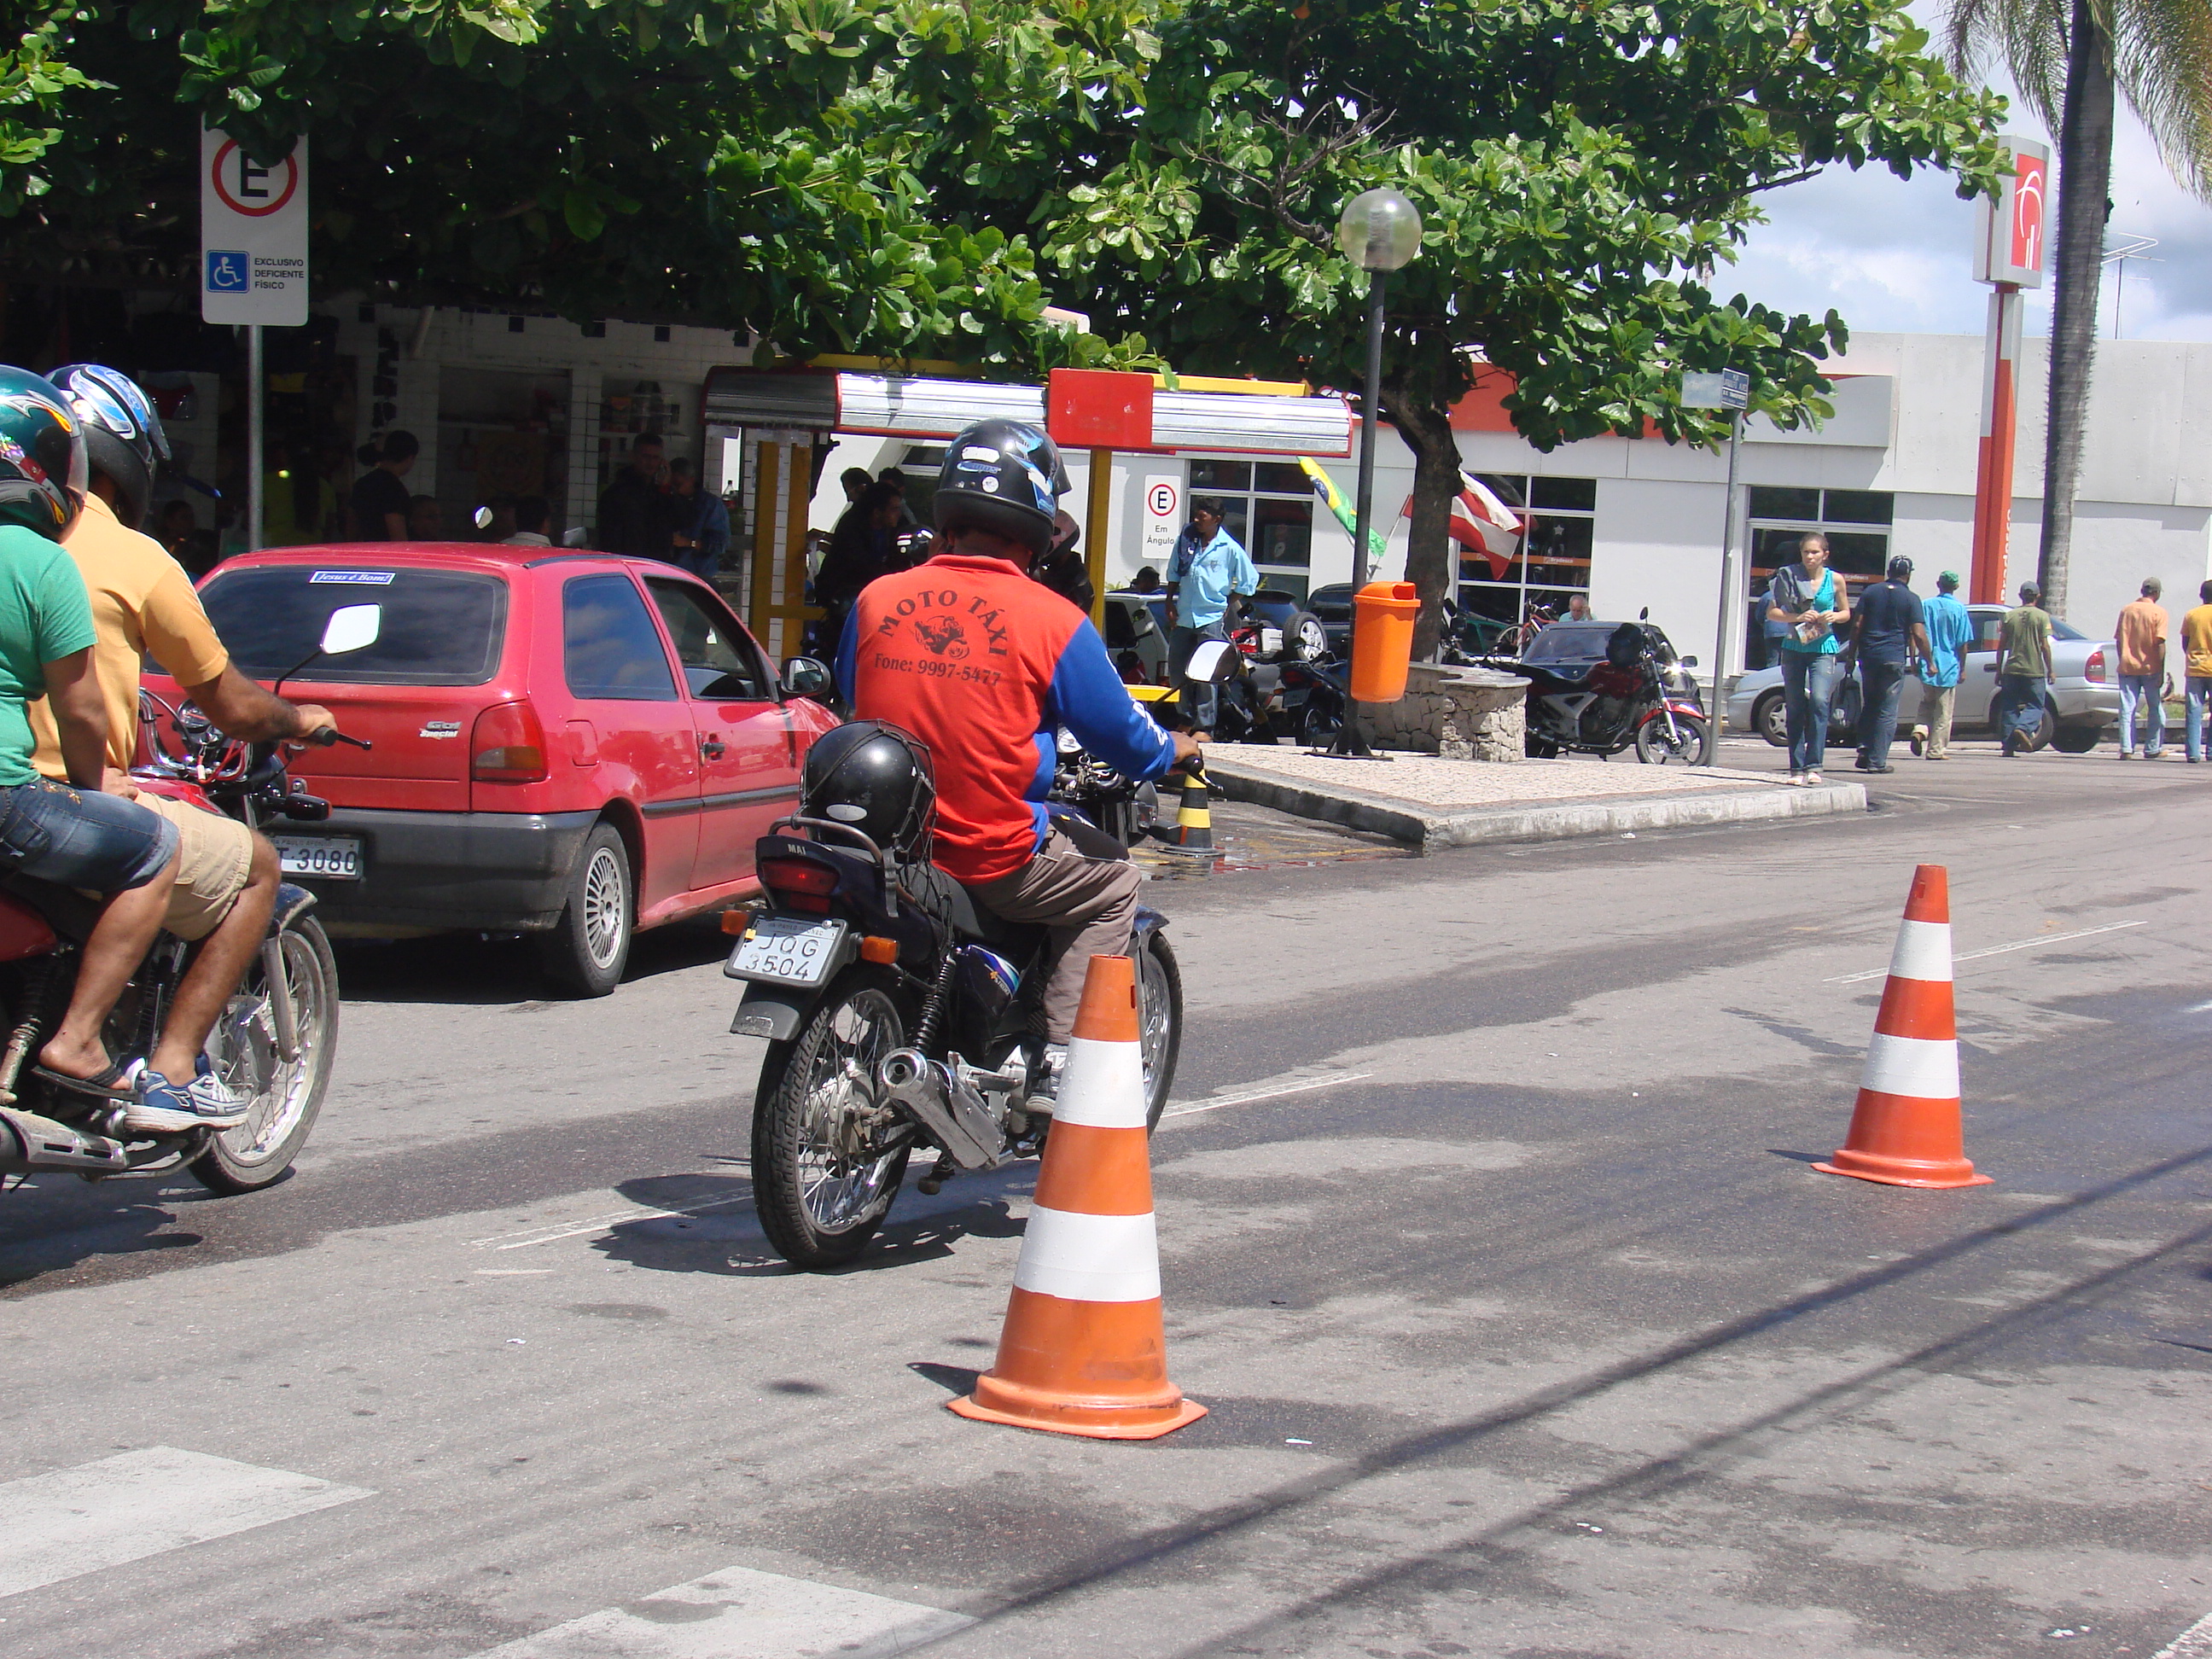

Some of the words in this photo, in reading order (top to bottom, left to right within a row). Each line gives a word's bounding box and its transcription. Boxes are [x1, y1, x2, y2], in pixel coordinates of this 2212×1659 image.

[240, 149, 269, 197] E
[254, 258, 304, 267] EXCLUSIVO
[254, 270, 305, 279] DEFICIENTE
[254, 280, 285, 289] FÍSICO
[1157, 491, 1167, 509] E
[1155, 525, 1168, 533] Em
[1146, 534, 1176, 546] Ângulo
[317, 573, 346, 582] Jesus
[877, 590, 958, 637] MOTO
[967, 596, 1008, 656] TÁXI
[874, 653, 913, 672] Fone:
[917, 659, 1002, 687] 9997-5477
[296, 848, 358, 873] 3080
[745, 952, 811, 980] 3504
